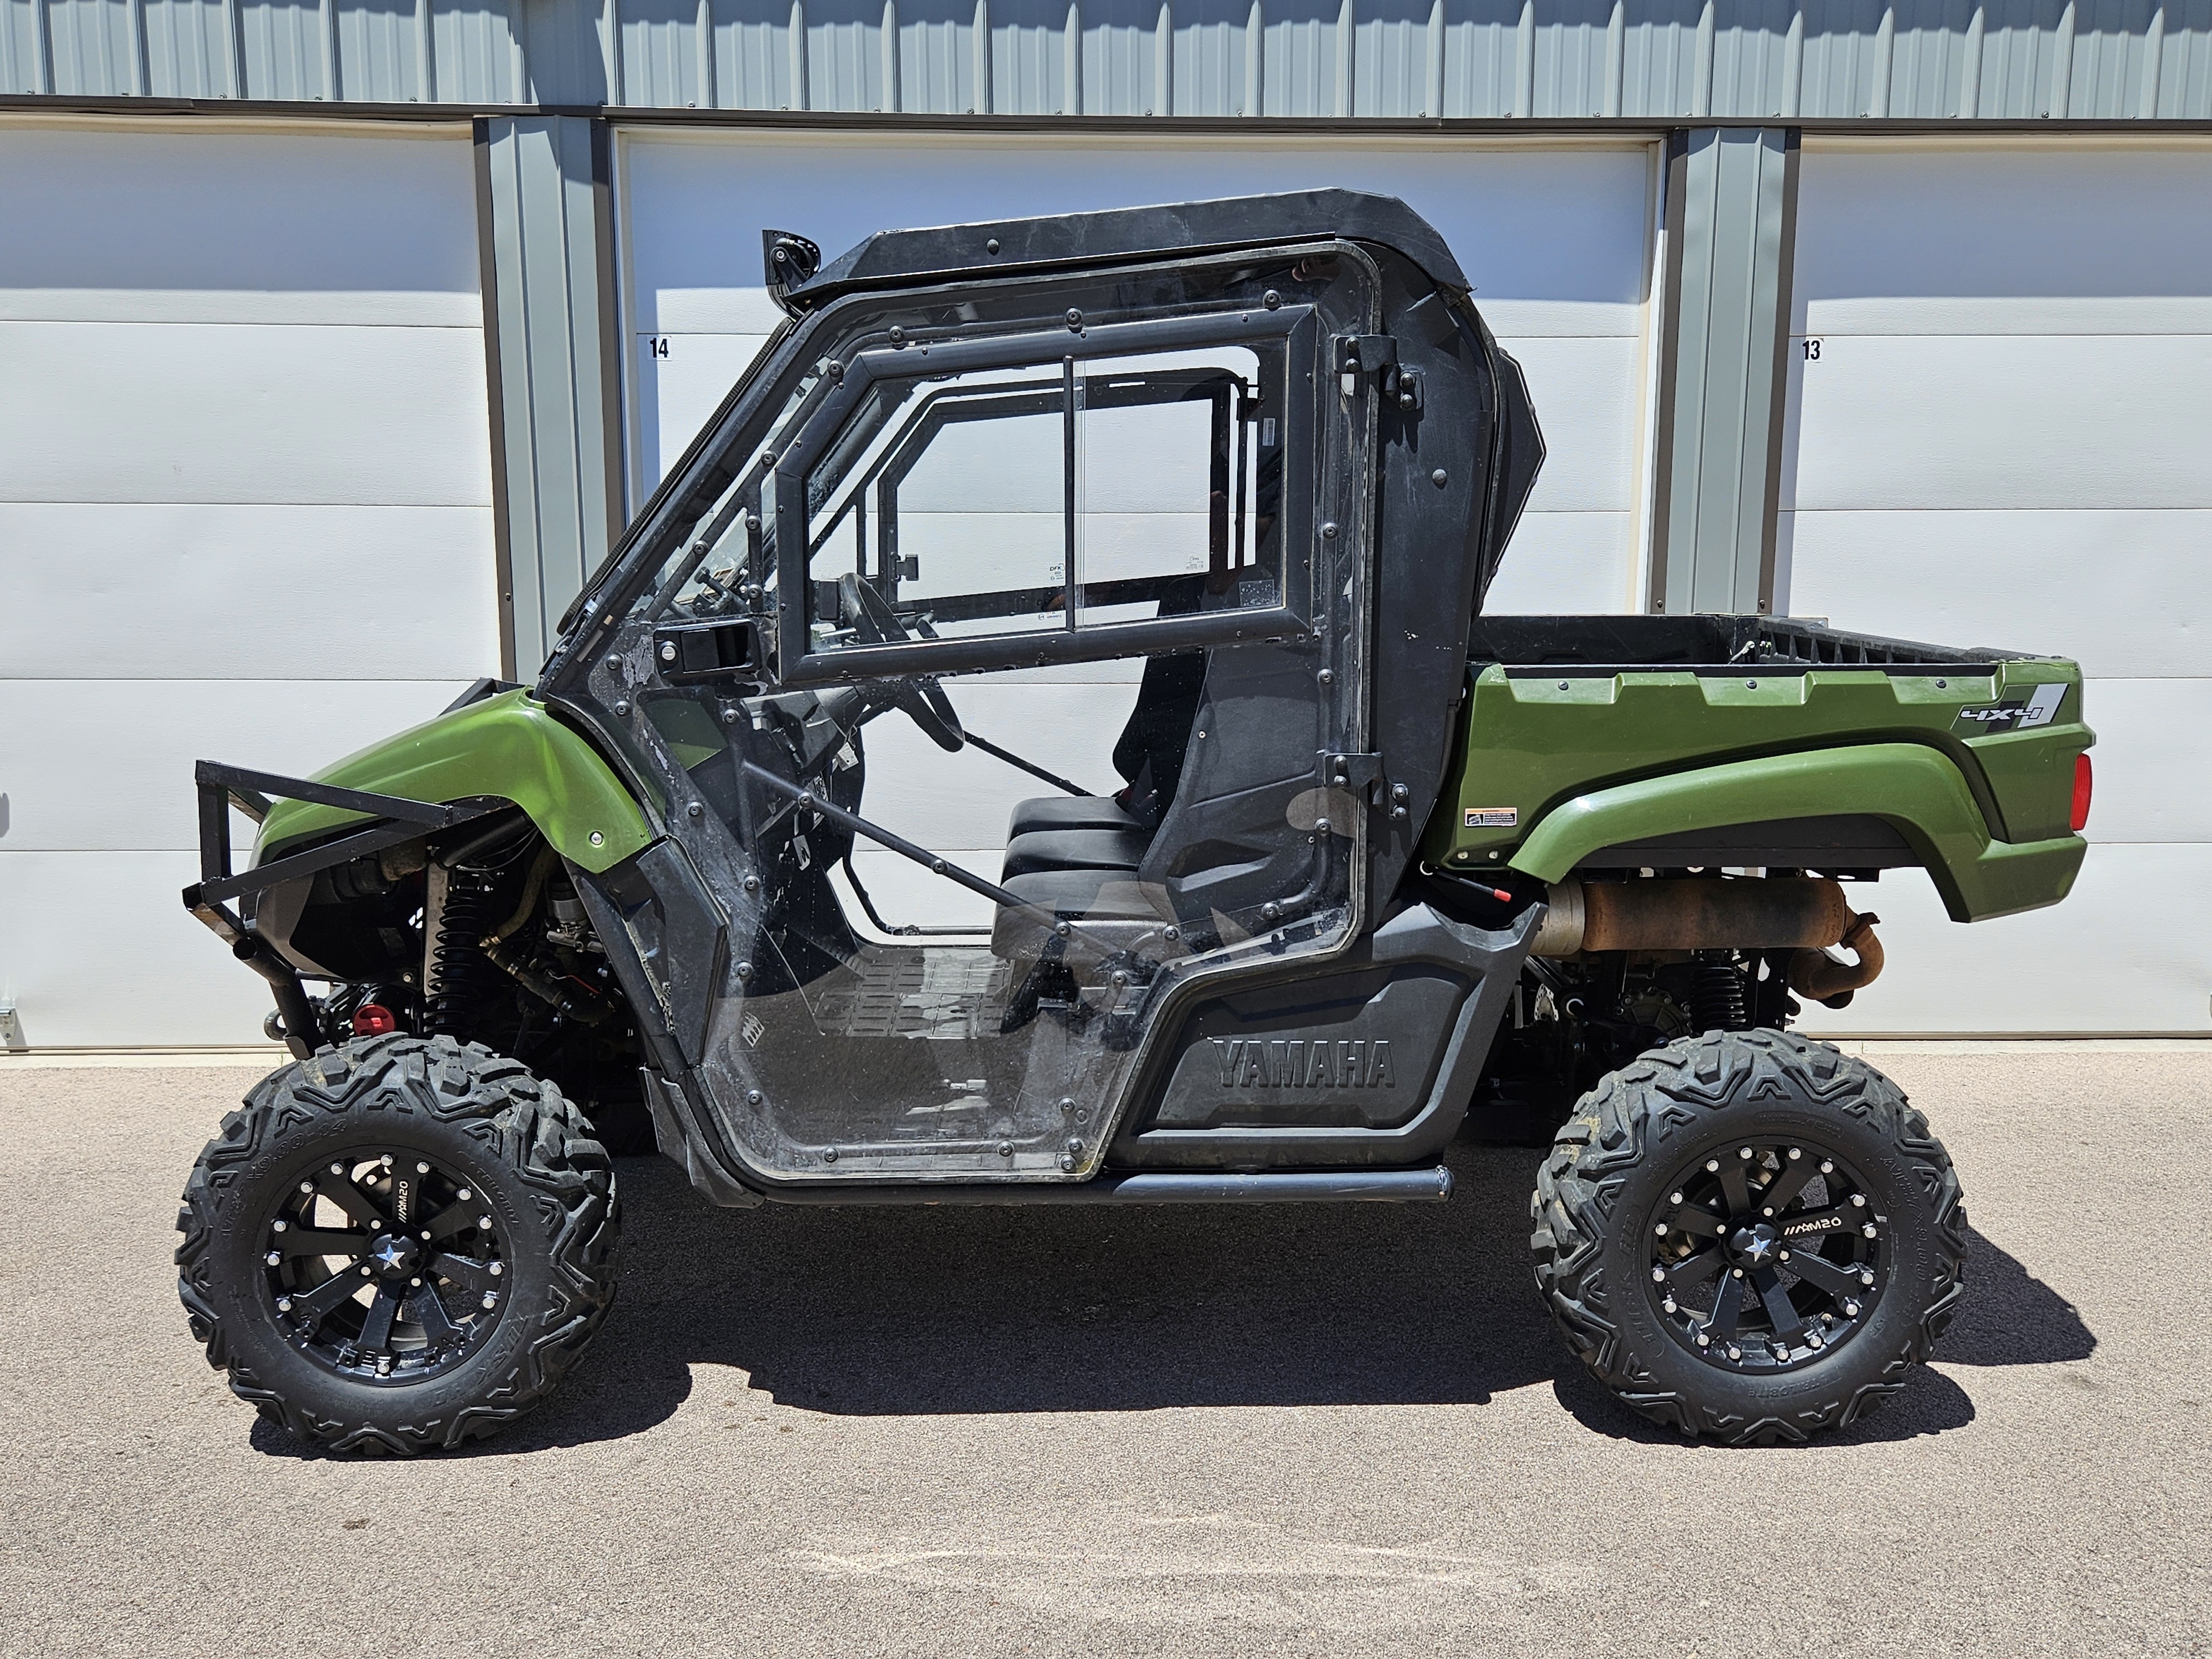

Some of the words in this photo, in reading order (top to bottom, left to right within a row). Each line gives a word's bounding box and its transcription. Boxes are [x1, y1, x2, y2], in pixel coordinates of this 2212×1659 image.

[650, 337, 669, 358] 14
[1803, 340, 1820, 360] 13
[1213, 1040, 1396, 1088] YAMAHA
